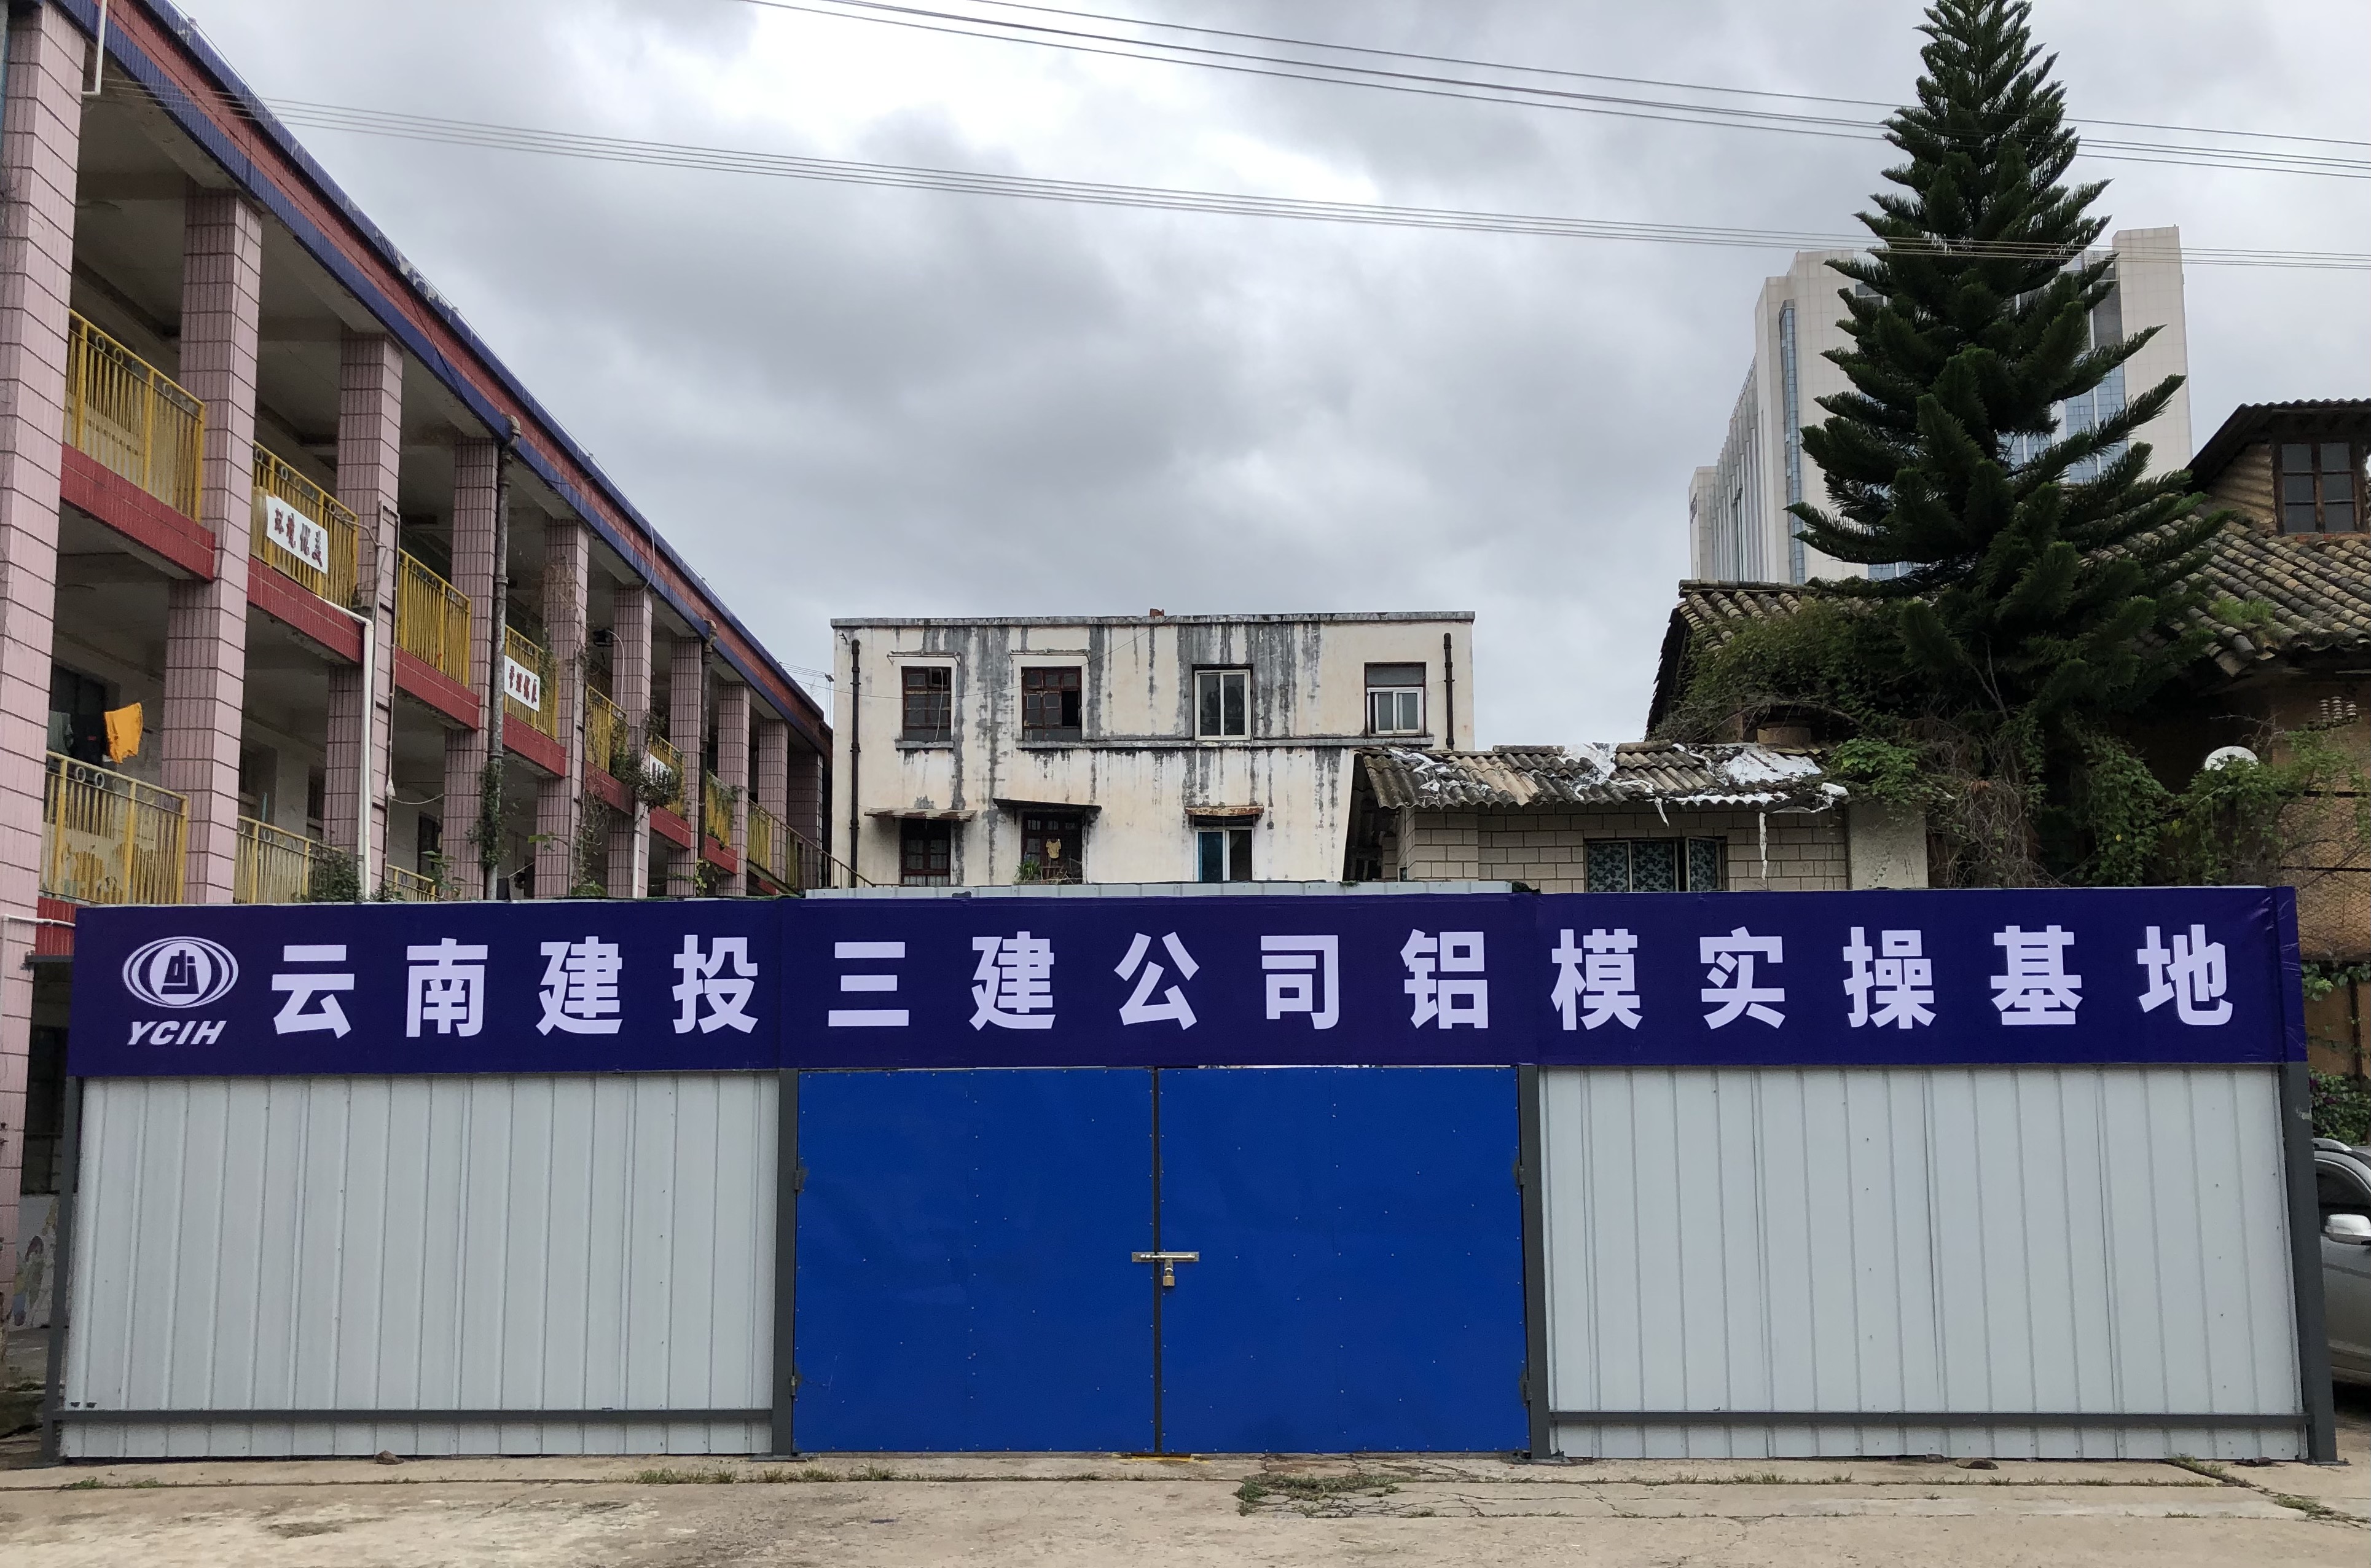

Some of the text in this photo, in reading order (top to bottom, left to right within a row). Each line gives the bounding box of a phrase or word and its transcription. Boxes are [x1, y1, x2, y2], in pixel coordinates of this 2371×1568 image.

[272, 924, 2233, 1040] 云南建投三建公司铝模实操基地
[127, 1021, 227, 1046] YCIH
